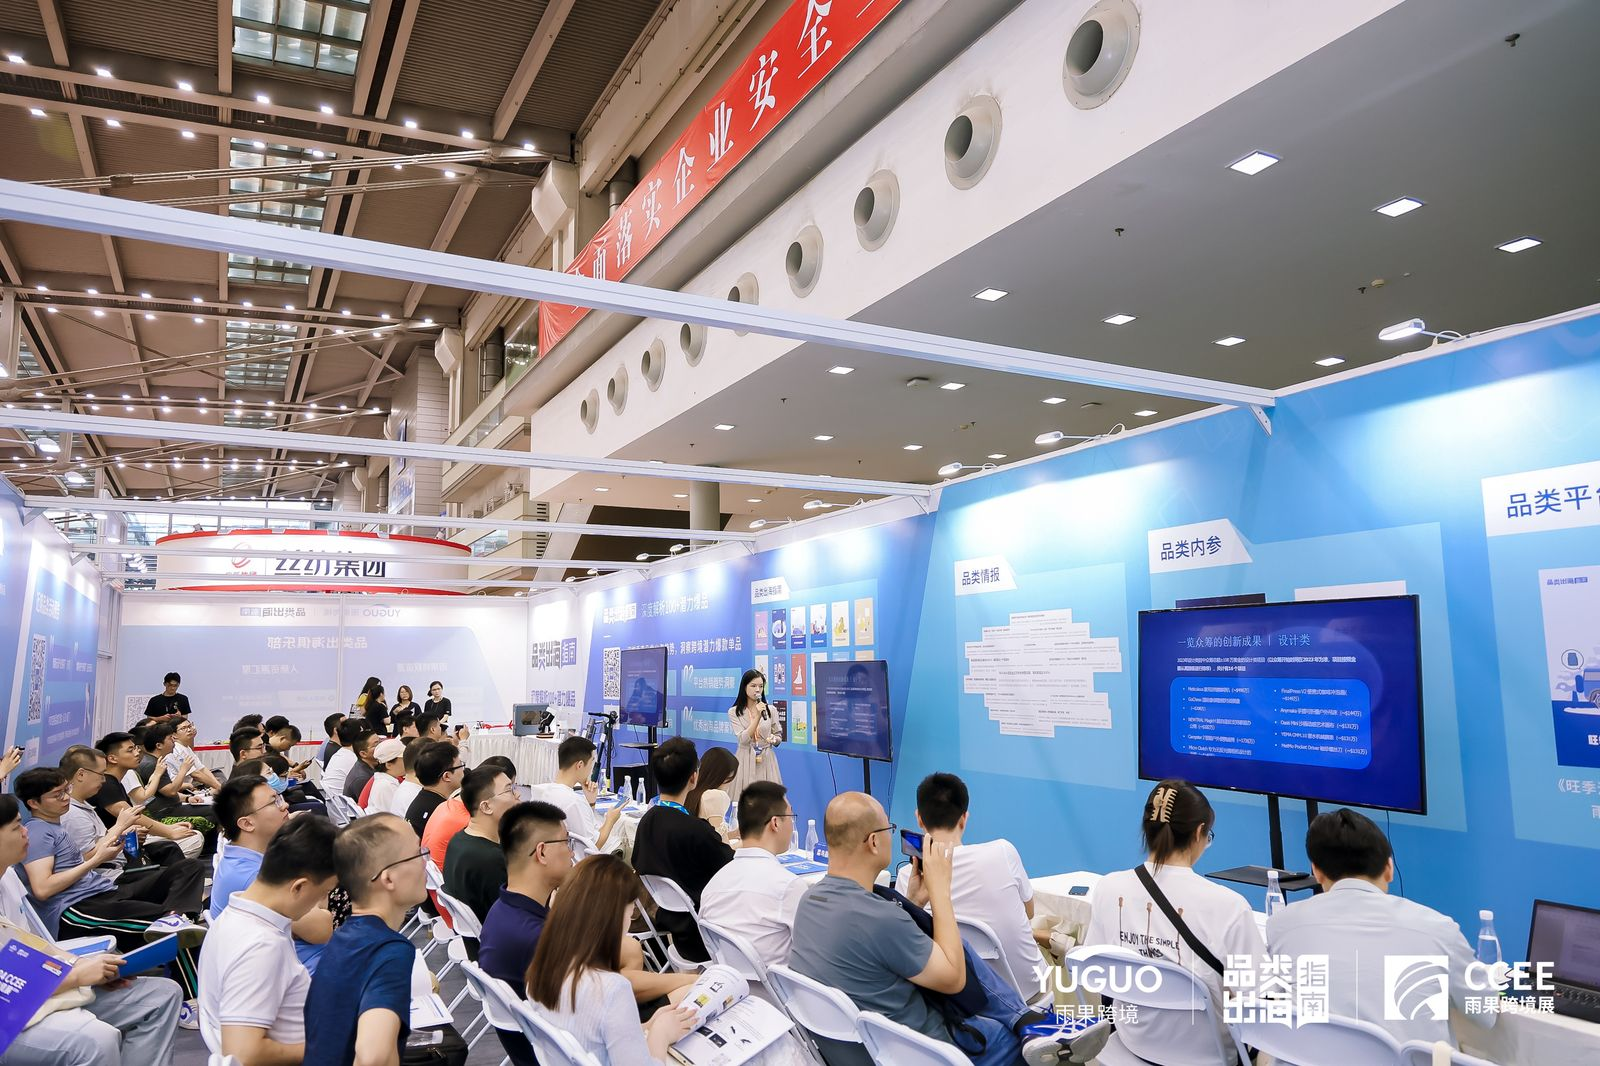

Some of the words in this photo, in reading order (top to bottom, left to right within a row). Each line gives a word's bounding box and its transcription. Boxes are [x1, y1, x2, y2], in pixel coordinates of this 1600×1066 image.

[1507, 484, 1600, 518] 品类平
[1160, 535, 1222, 561] 品类内参
[962, 567, 1000, 586] 品类情报
[1177, 634, 1262, 649] 一览众筹的创新成果
[1278, 634, 1311, 647] 设计类
[1588, 734, 1600, 746] 旺
[1558, 778, 1600, 795] 《旺季
[1119, 931, 1139, 945] ENJOY
[1140, 934, 1154, 945] THE
[1155, 937, 1180, 950] SIMPLE
